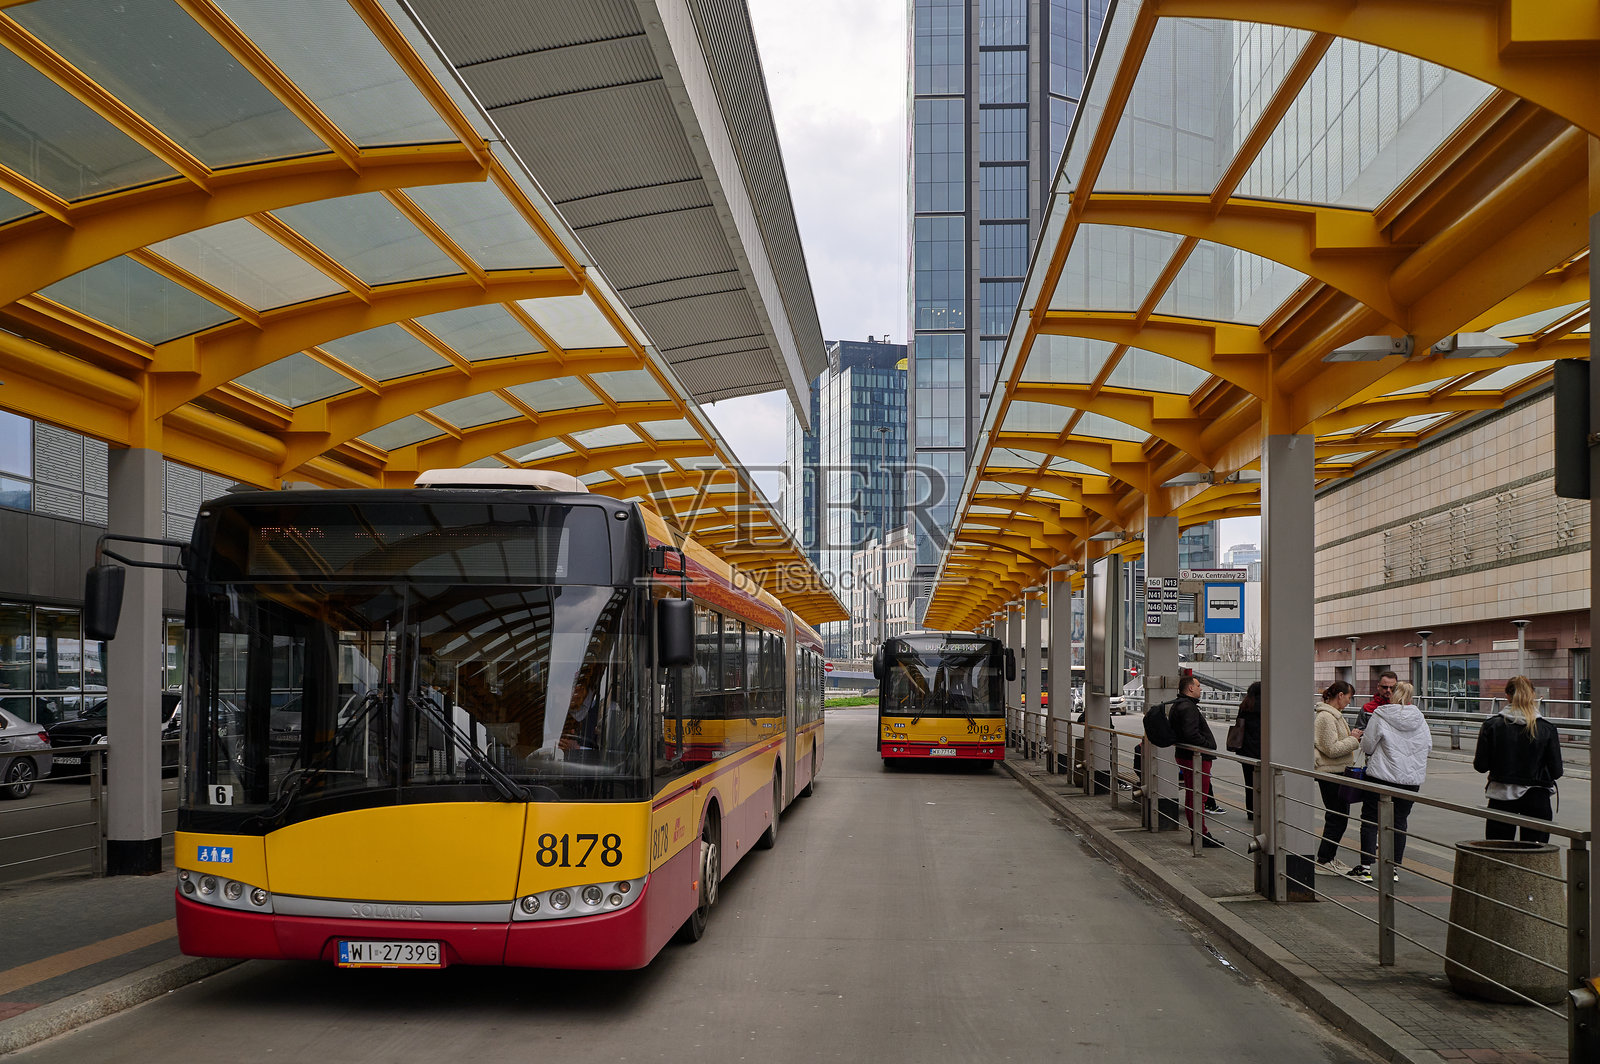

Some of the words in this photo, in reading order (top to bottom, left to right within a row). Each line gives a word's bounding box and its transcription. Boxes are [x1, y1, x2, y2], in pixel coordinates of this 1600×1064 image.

[1206, 572, 1236, 580] Centralny
[1164, 579, 1177, 587] N13
[1148, 591, 1161, 599] N41
[1163, 591, 1178, 599] N44
[1147, 603, 1161, 611] N46
[1163, 603, 1177, 611] N63
[967, 724, 990, 735] 2019
[214, 785, 227, 805] 6
[653, 822, 669, 861] 8178
[535, 833, 623, 868] 8178
[351, 903, 424, 920] SOLARIS
[351, 944, 372, 961] WI
[383, 944, 437, 961] 2739G
